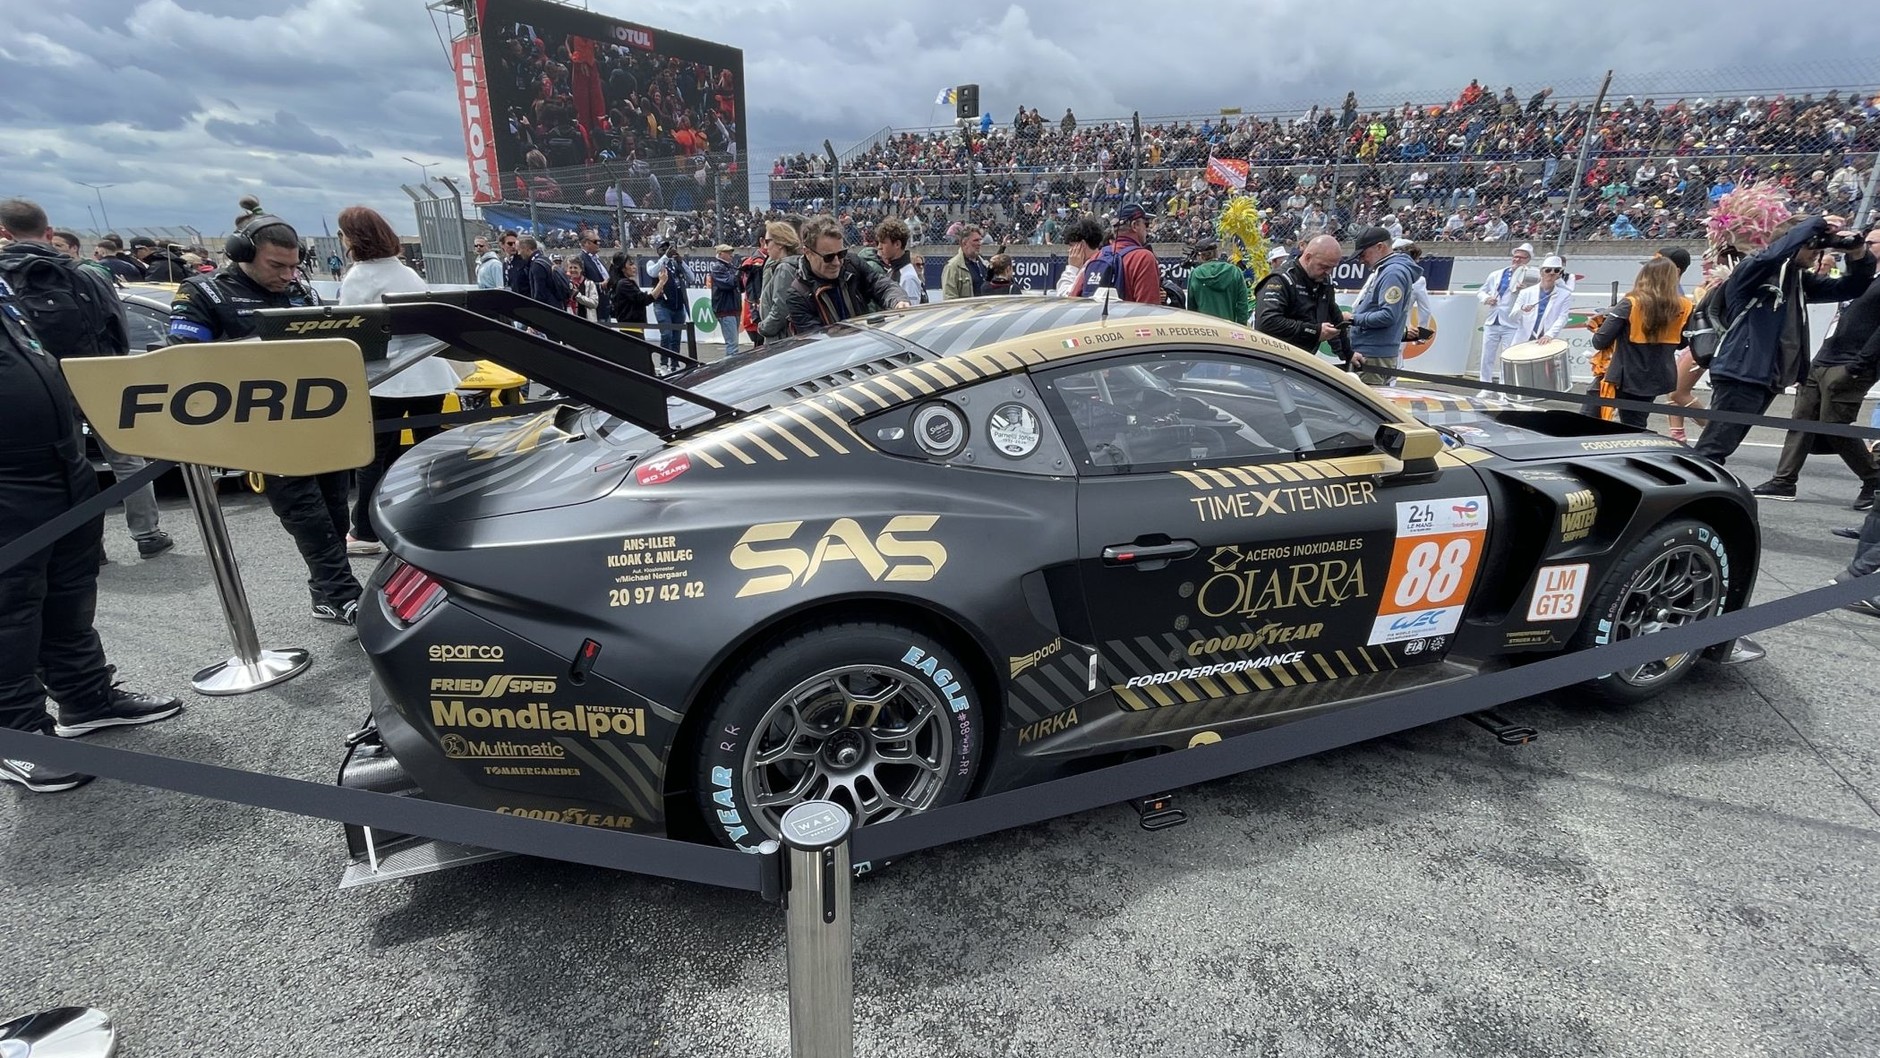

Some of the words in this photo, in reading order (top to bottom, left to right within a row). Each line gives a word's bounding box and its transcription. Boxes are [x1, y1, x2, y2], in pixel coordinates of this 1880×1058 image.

[461, 53, 495, 198] MOTUL
[689, 259, 716, 272] RÉGIO
[1012, 261, 1049, 276] GION
[285, 315, 366, 333] spark
[1156, 328, 1168, 336] M.
[1170, 328, 1219, 337] PEDERSEN
[1084, 336, 1096, 344] G.
[1096, 331, 1124, 343] RODA
[1250, 335, 1260, 343] D.
[1261, 338, 1291, 352] OLSEN
[118, 377, 348, 430] FORD
[1018, 433, 1036, 442] Jones
[660, 464, 687, 477] YEARS
[1190, 481, 1377, 521] TIMEXTENDER
[1565, 489, 1595, 512] BLUE
[1561, 507, 1597, 533] WATER
[623, 536, 676, 551] ANS-ILLER
[1245, 546, 1291, 562] ACEROS
[1293, 538, 1363, 557] INOXIDABLES
[607, 553, 642, 568] KLOAK
[644, 552, 654, 564] &
[656, 549, 693, 563] ANLÆG
[730, 514, 948, 598] SAS
[615, 573, 652, 583] v/Michael
[1395, 538, 1472, 607] 88
[1545, 569, 1577, 594] LM
[609, 588, 631, 607] 20
[634, 586, 655, 604] 97
[659, 583, 680, 601] 42
[684, 581, 705, 598] 42
[1197, 557, 1369, 618] OLARRA
[1536, 593, 1574, 617] GT3
[1390, 610, 1446, 631] WEC
[1188, 622, 1324, 656] GOODYEAR
[1405, 639, 1425, 653] FIA
[429, 644, 504, 662] sparco
[1033, 637, 1061, 667] paoli
[430, 678, 485, 692] FRIED
[508, 680, 557, 694] SPED
[901, 645, 970, 713] EAGLE
[430, 700, 645, 738] Mondialpol
[586, 705, 635, 714] VEDETTA2
[1018, 707, 1078, 746] KIRKA
[468, 740, 565, 757] Multimatic
[798, 815, 832, 831] WAS
